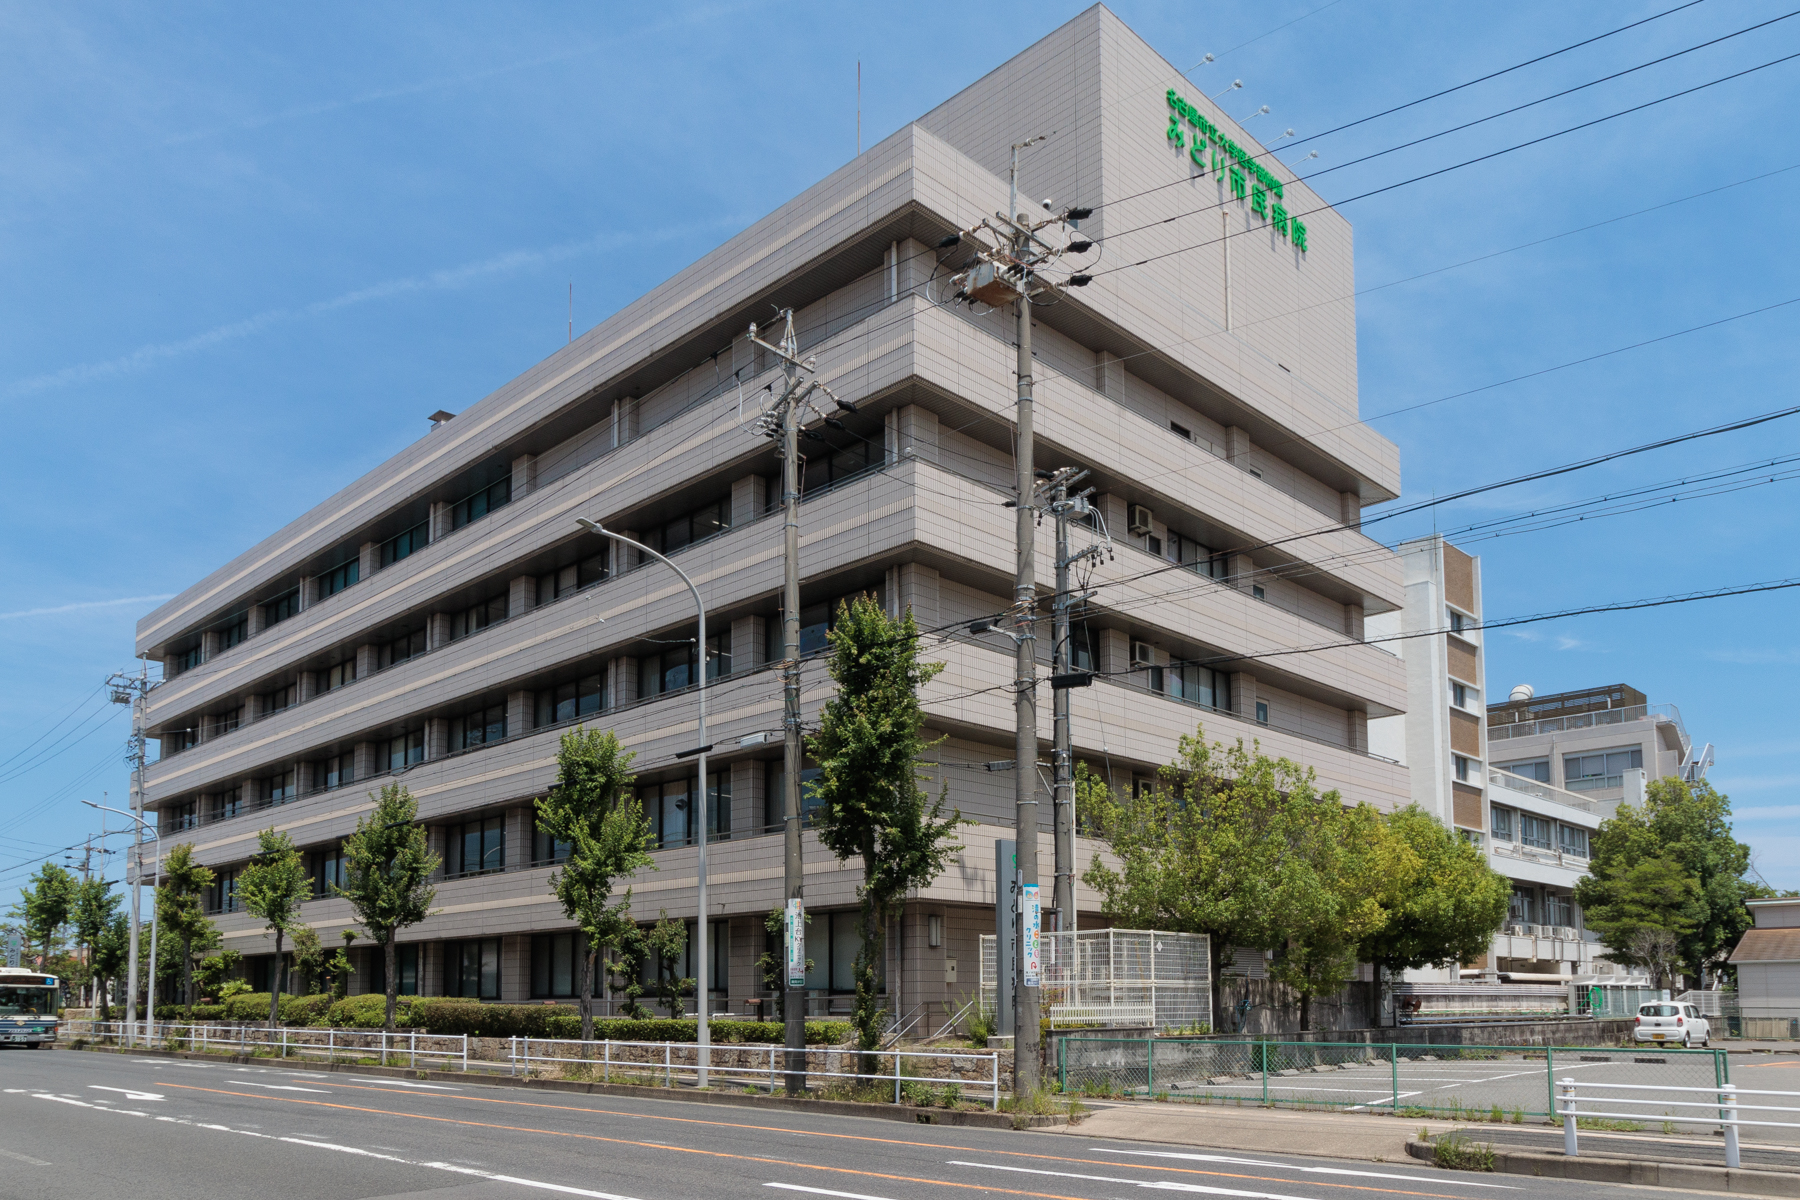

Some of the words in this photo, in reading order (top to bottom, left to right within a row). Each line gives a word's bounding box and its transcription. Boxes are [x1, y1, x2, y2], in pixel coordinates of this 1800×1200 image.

[1167, 114, 1308, 252] みどり市民病院
[1025, 927, 1033, 958] クリニック
